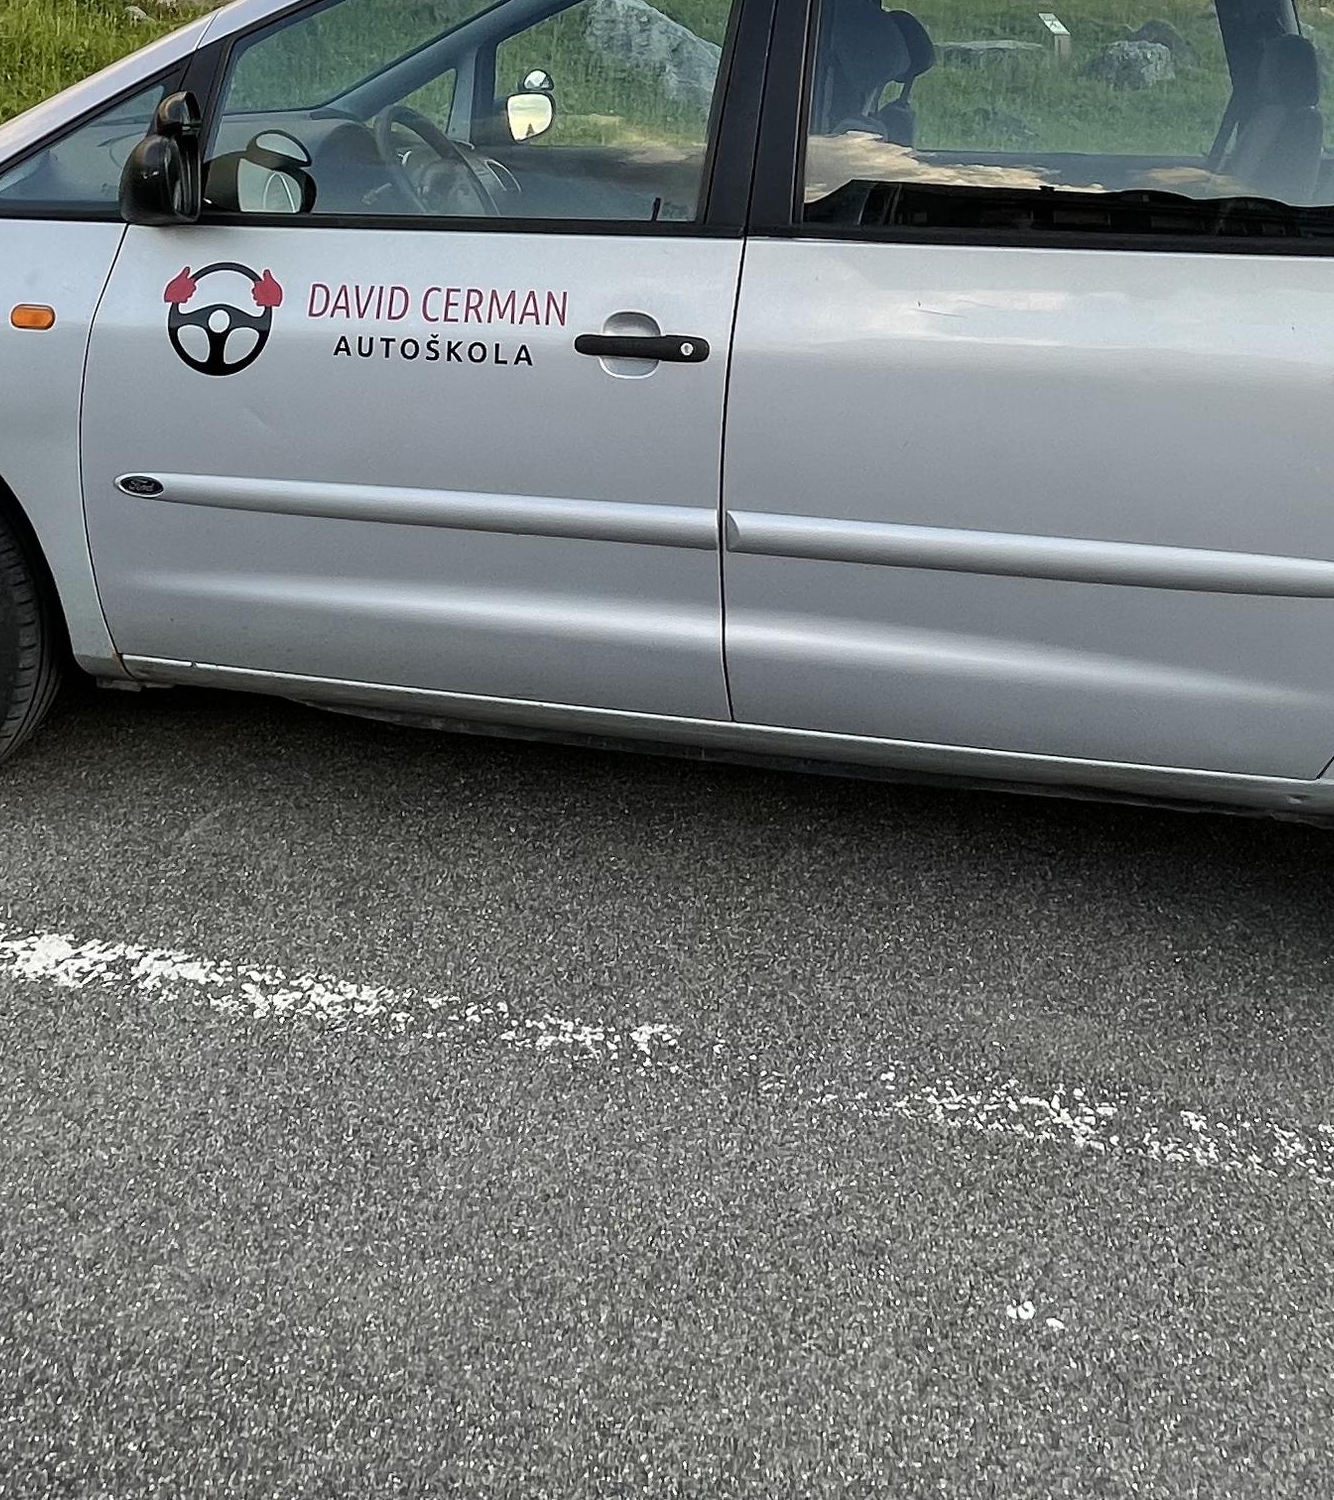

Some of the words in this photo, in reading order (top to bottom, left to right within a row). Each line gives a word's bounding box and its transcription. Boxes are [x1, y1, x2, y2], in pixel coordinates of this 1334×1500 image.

[308, 283, 410, 321] DAVID
[421, 286, 568, 326] CERMAN
[333, 333, 534, 366] AUTOŠKOLA
